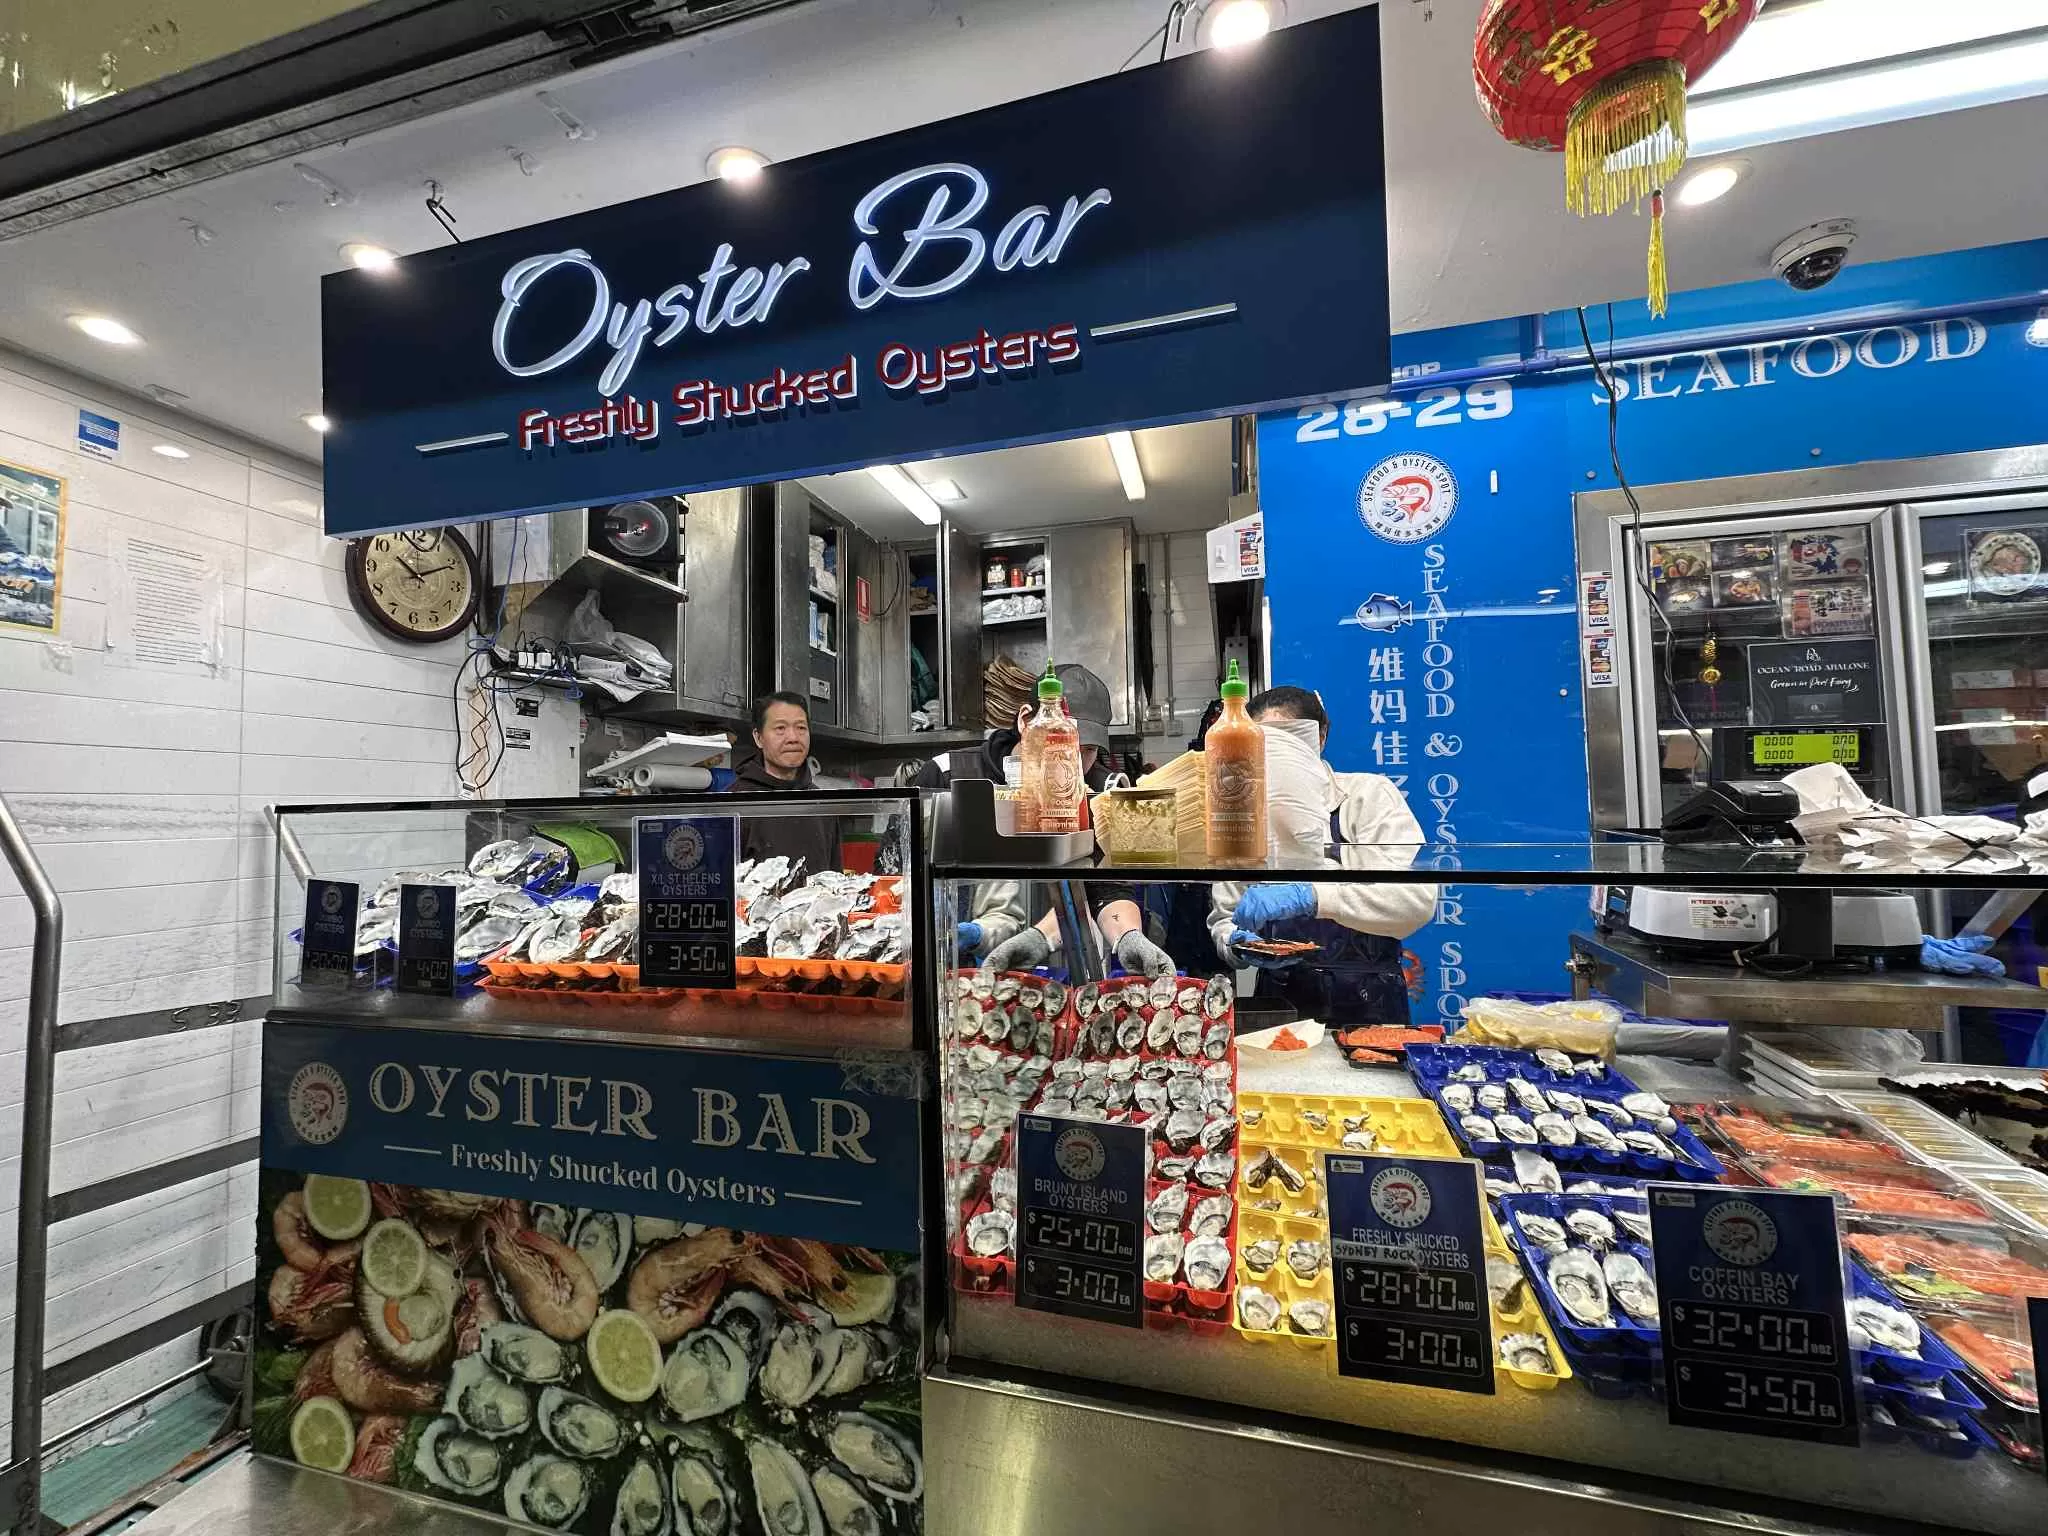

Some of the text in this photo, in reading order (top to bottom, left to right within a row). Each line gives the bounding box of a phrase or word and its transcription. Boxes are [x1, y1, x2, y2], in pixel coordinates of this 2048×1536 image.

[492, 162, 1112, 397] Oyster Bar
[1391, 361, 1440, 379] OP
[1592, 316, 1988, 405] SEAFOOD
[518, 322, 1080, 451] Freshly Shucked Oysters
[1296, 380, 1514, 443] 28-29
[1364, 465, 1390, 502] SEAFOOD
[1402, 458, 1437, 474] OYSTER
[1435, 472, 1451, 494] SPOT
[1243, 566, 1259, 574] VISA
[1421, 544, 1455, 718] SEAFOOD
[1757, 661, 1870, 674] OCEAN ROAD ABALONE
[1424, 732, 1463, 757] &
[667, 873, 680, 885] ST
[682, 872, 722, 885] HELENS
[662, 885, 708, 896] OYSTERS
[368, 1062, 877, 1164] OYSTER BAR
[451, 1143, 776, 1207] Freshly Shucked Oysters
[1034, 1178, 1128, 1204] BRUNY ISLAND
[1049, 1193, 1108, 1214] OYSTERS
[1028, 1212, 1036, 1224] $
[1352, 1227, 1459, 1251] FRESHLY SHUCKED
[1335, 1244, 1417, 1261] SYDNEY ROCK
[1418, 1250, 1470, 1269] OYSTERS
[1027, 1260, 1035, 1272] $
[1346, 1267, 1354, 1282] $
[1688, 1266, 1800, 1290] COFFIN BAY
[1702, 1282, 1789, 1305] OYSTERS
[1674, 1306, 1685, 1321] $
[1350, 1322, 1359, 1336] $
[1680, 1366, 1691, 1381] $
